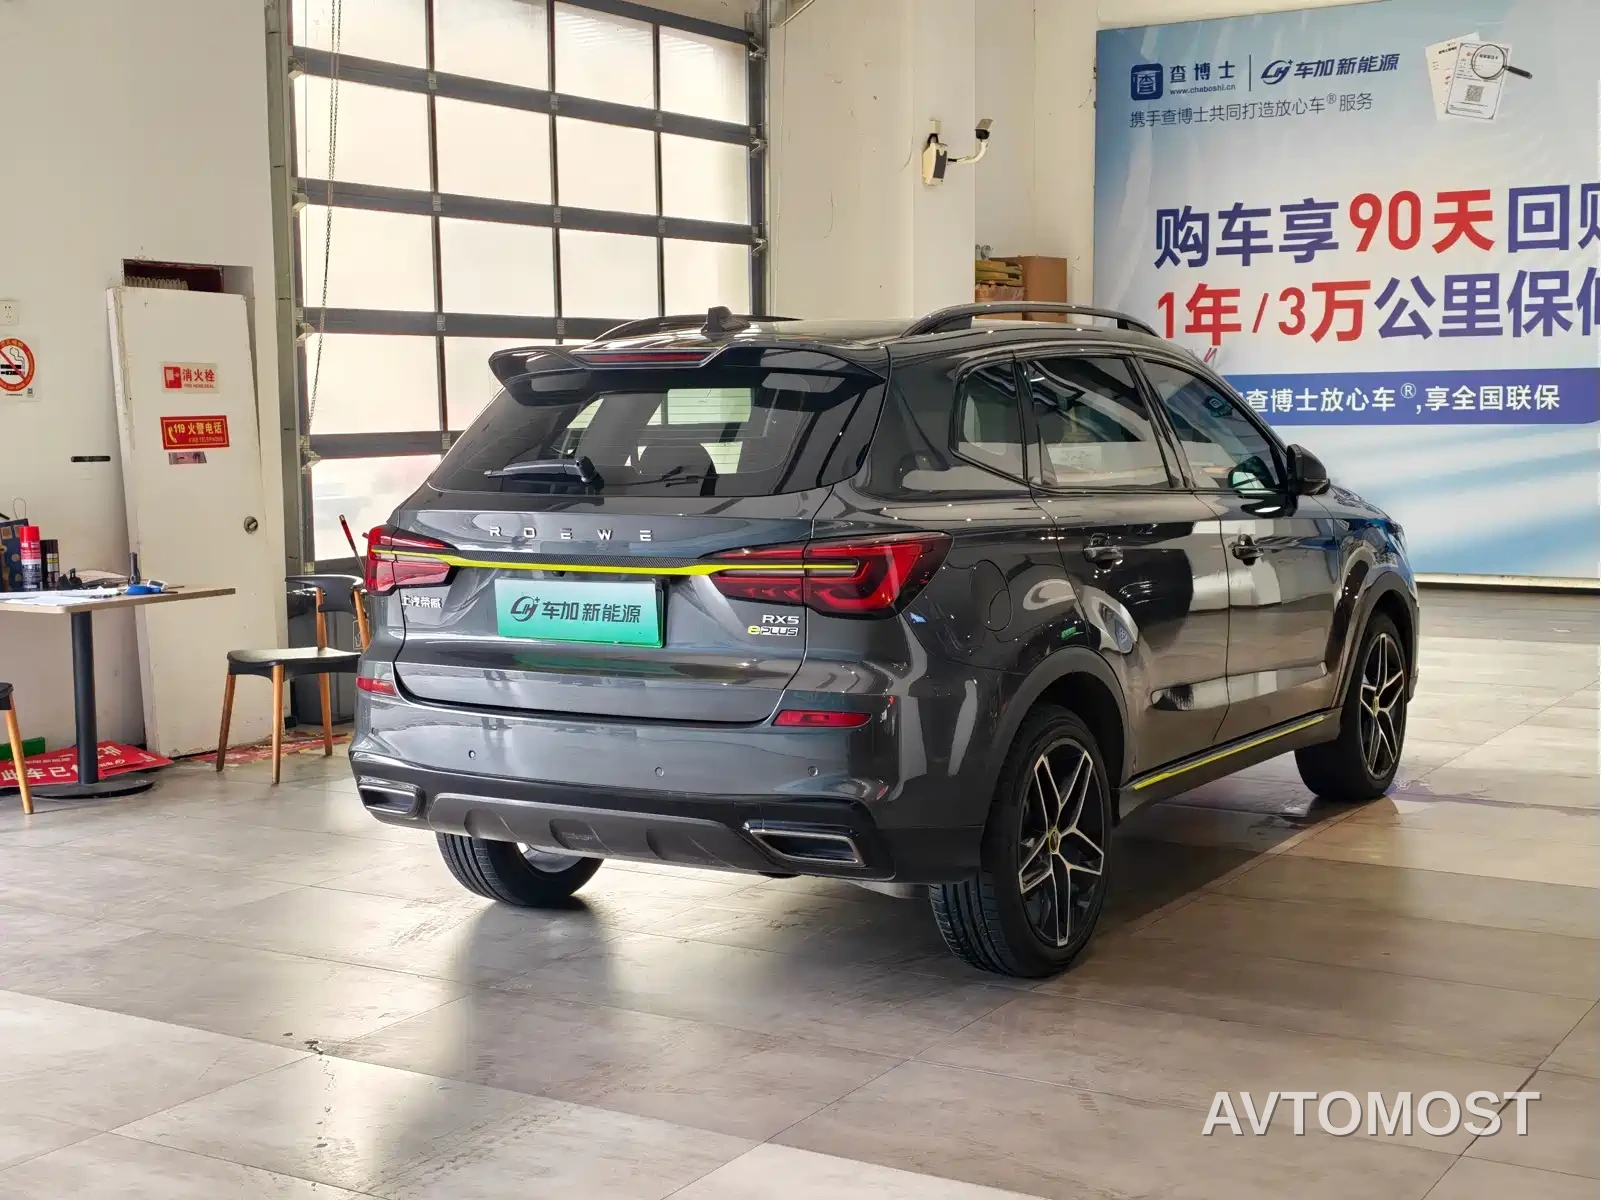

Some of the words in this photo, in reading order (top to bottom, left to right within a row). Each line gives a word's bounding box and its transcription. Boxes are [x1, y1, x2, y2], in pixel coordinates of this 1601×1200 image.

[1169, 60, 1236, 84] 查博士
[1294, 53, 1400, 79] 车加新能源
[1169, 83, 1236, 95] www.chaboshi.cn
[182, 368, 215, 382] 消火栓
[174, 423, 185, 434] 119
[187, 422, 222, 435] 火警电话
[489, 526, 653, 542] ROEWE
[402, 595, 443, 608] 上汽荣威
[541, 601, 641, 624] 车加新能源
[762, 614, 800, 624] RX5
[747, 625, 799, 636] ePLUS
